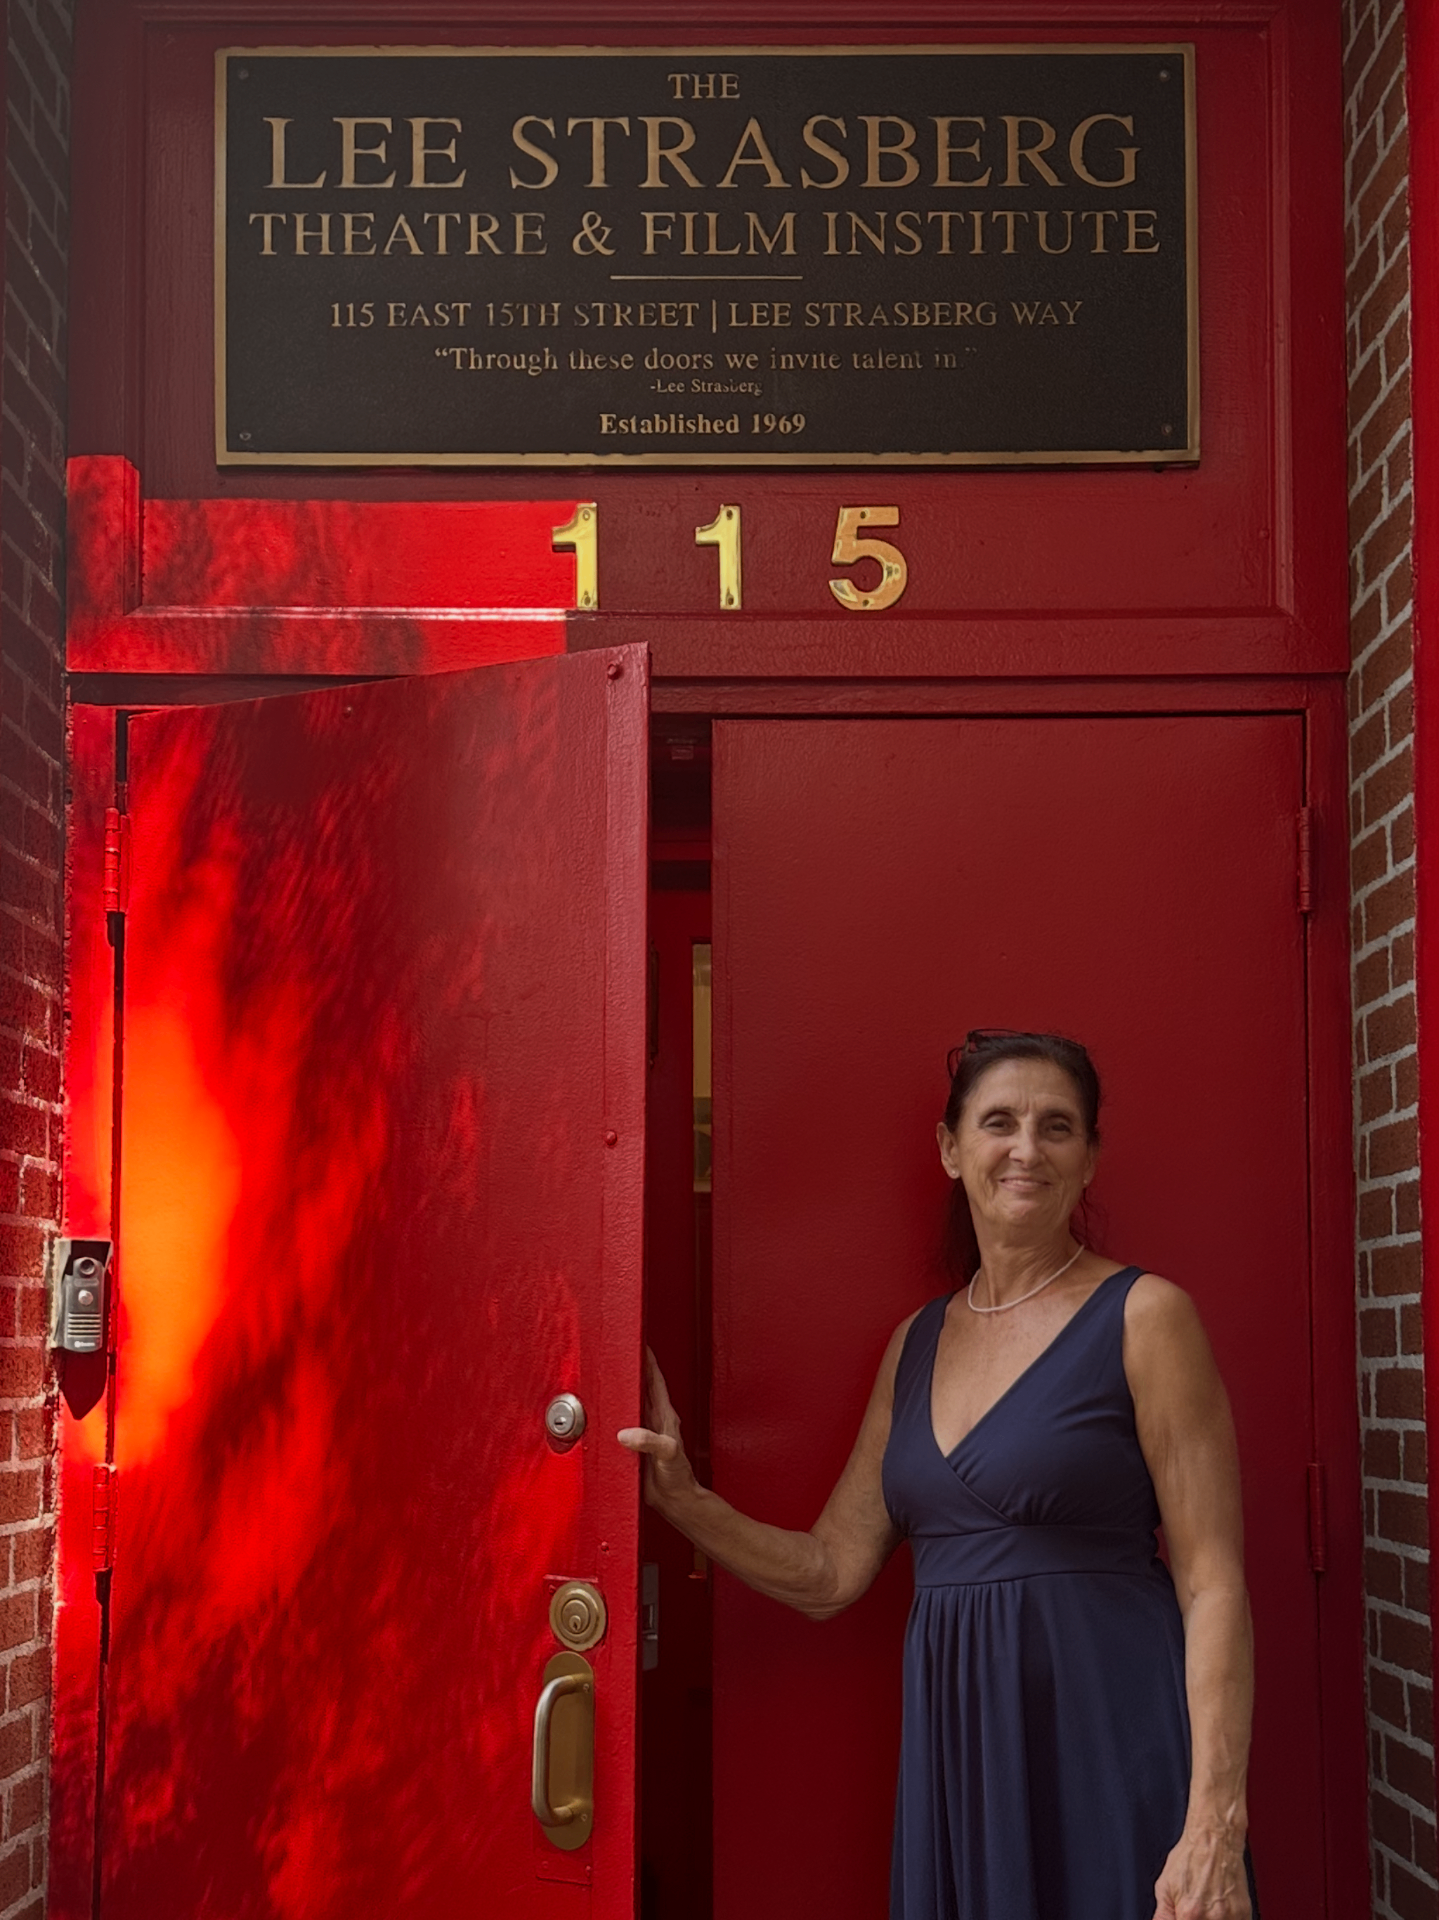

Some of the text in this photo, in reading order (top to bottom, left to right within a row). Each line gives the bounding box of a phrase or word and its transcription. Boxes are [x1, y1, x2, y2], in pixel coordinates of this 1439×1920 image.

[667, 73, 740, 99] THE
[262, 113, 1141, 191] LEE STRASBERG
[248, 209, 1161, 256] THEATRE & FILM INSTITUTE
[330, 302, 374, 328] 115
[387, 302, 471, 328] EAST
[486, 302, 561, 328] 15TH
[573, 302, 699, 328] STREET
[728, 301, 792, 328] LEE
[804, 301, 998, 327] STRASBERG
[1010, 300, 1083, 327] WAY
[569, 347, 634, 370] these
[644, 347, 714, 370] doors
[724, 352, 759, 370] we
[770, 346, 842, 370] invite
[852, 347, 924, 370] talent
[599, 412, 807, 435] Established 1969
